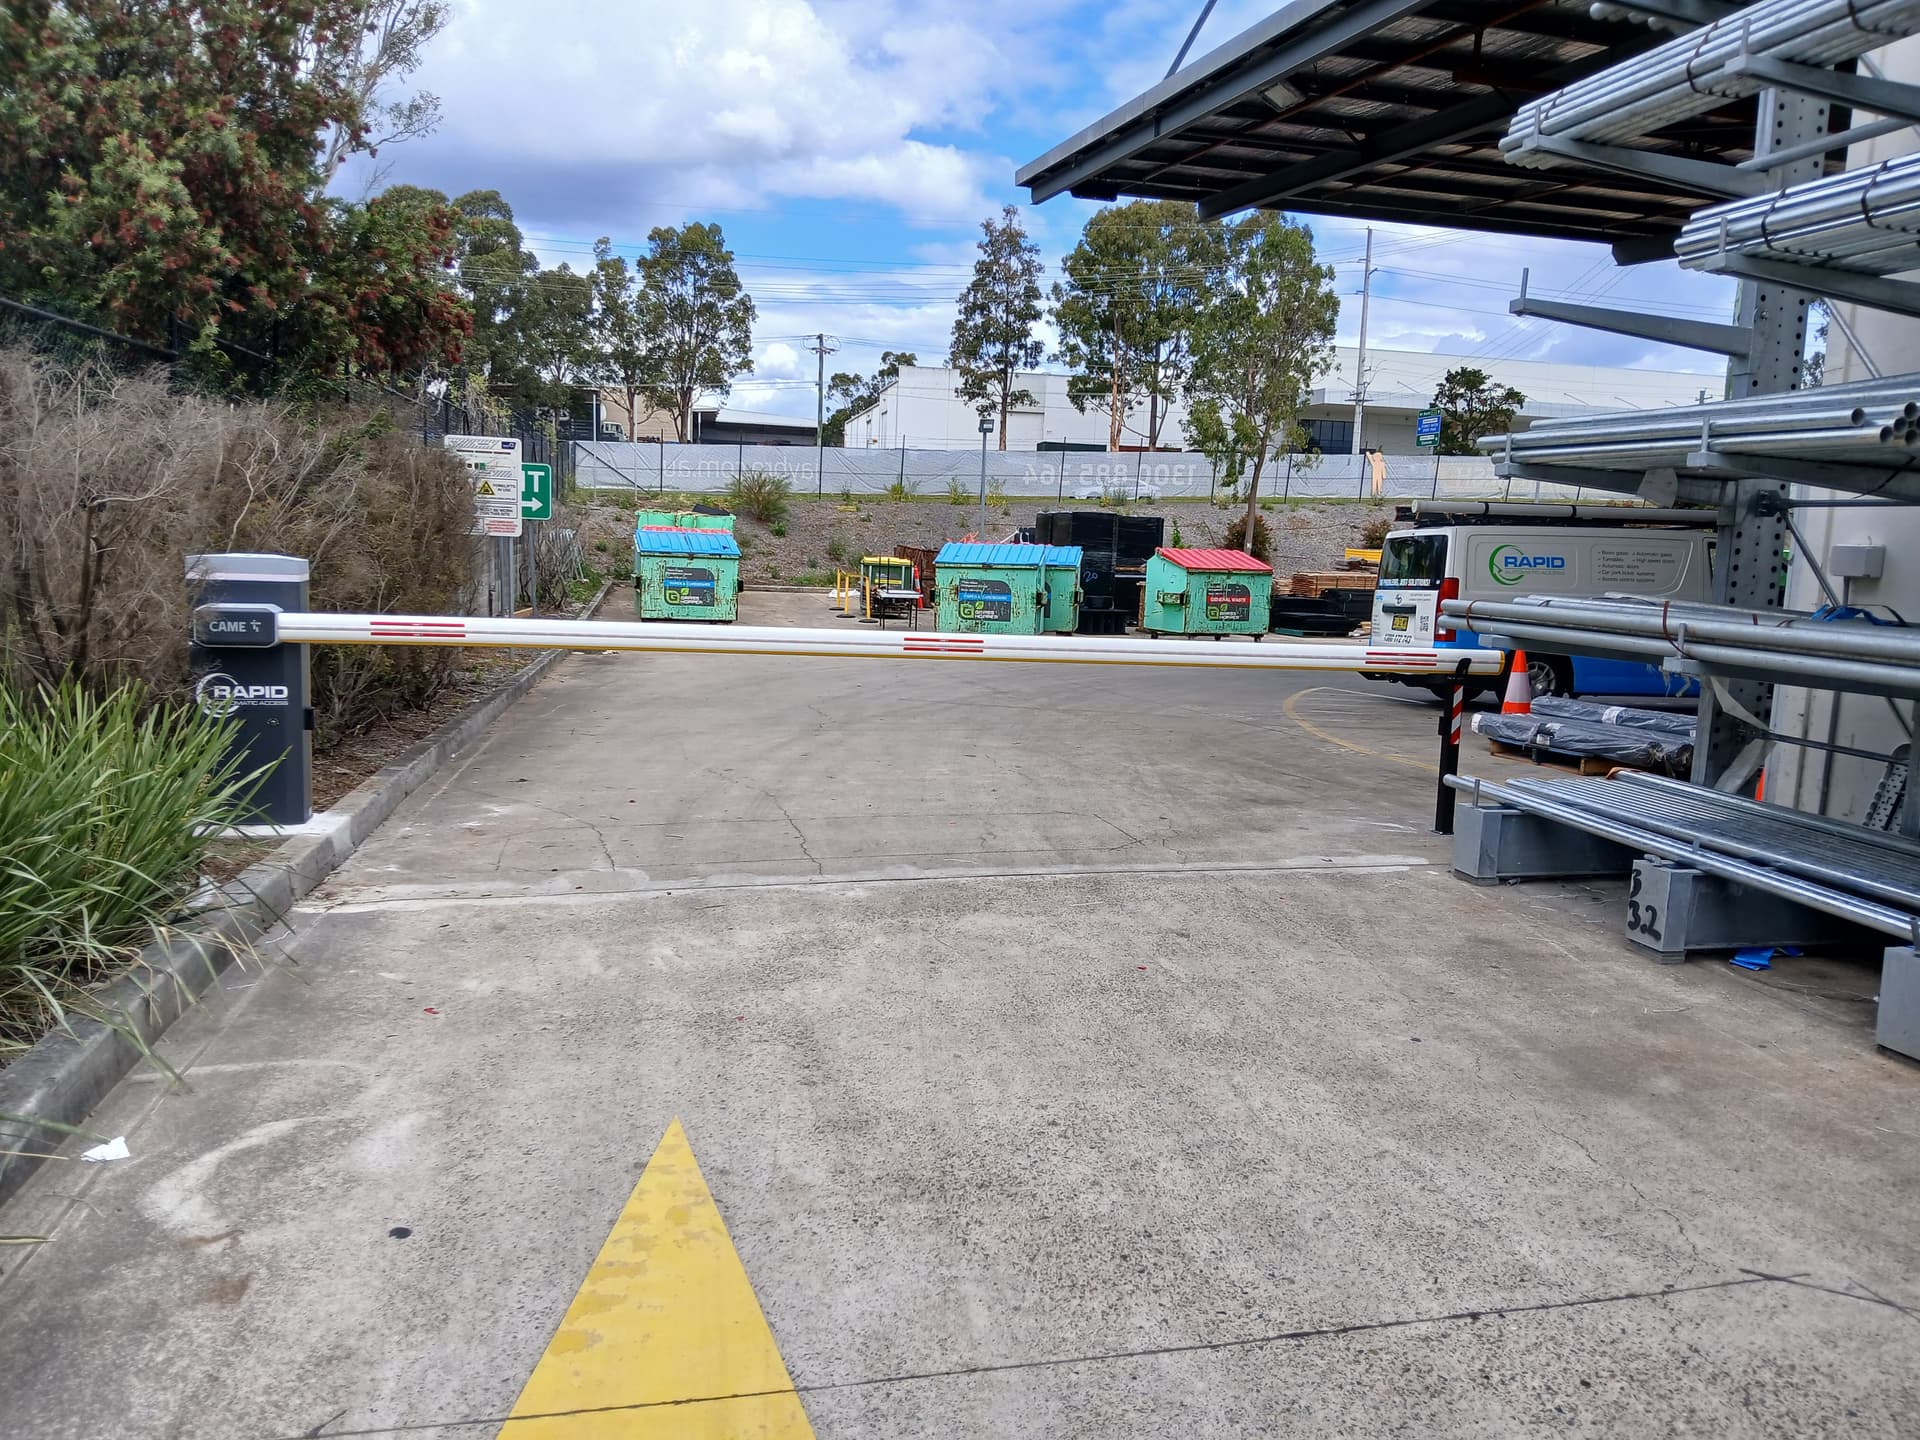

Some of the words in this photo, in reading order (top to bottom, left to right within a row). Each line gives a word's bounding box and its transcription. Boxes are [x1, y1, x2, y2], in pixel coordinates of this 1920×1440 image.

[1504, 556, 1565, 568] RAPID
[209, 621, 247, 632] CAME
[213, 685, 288, 698] RAPID
